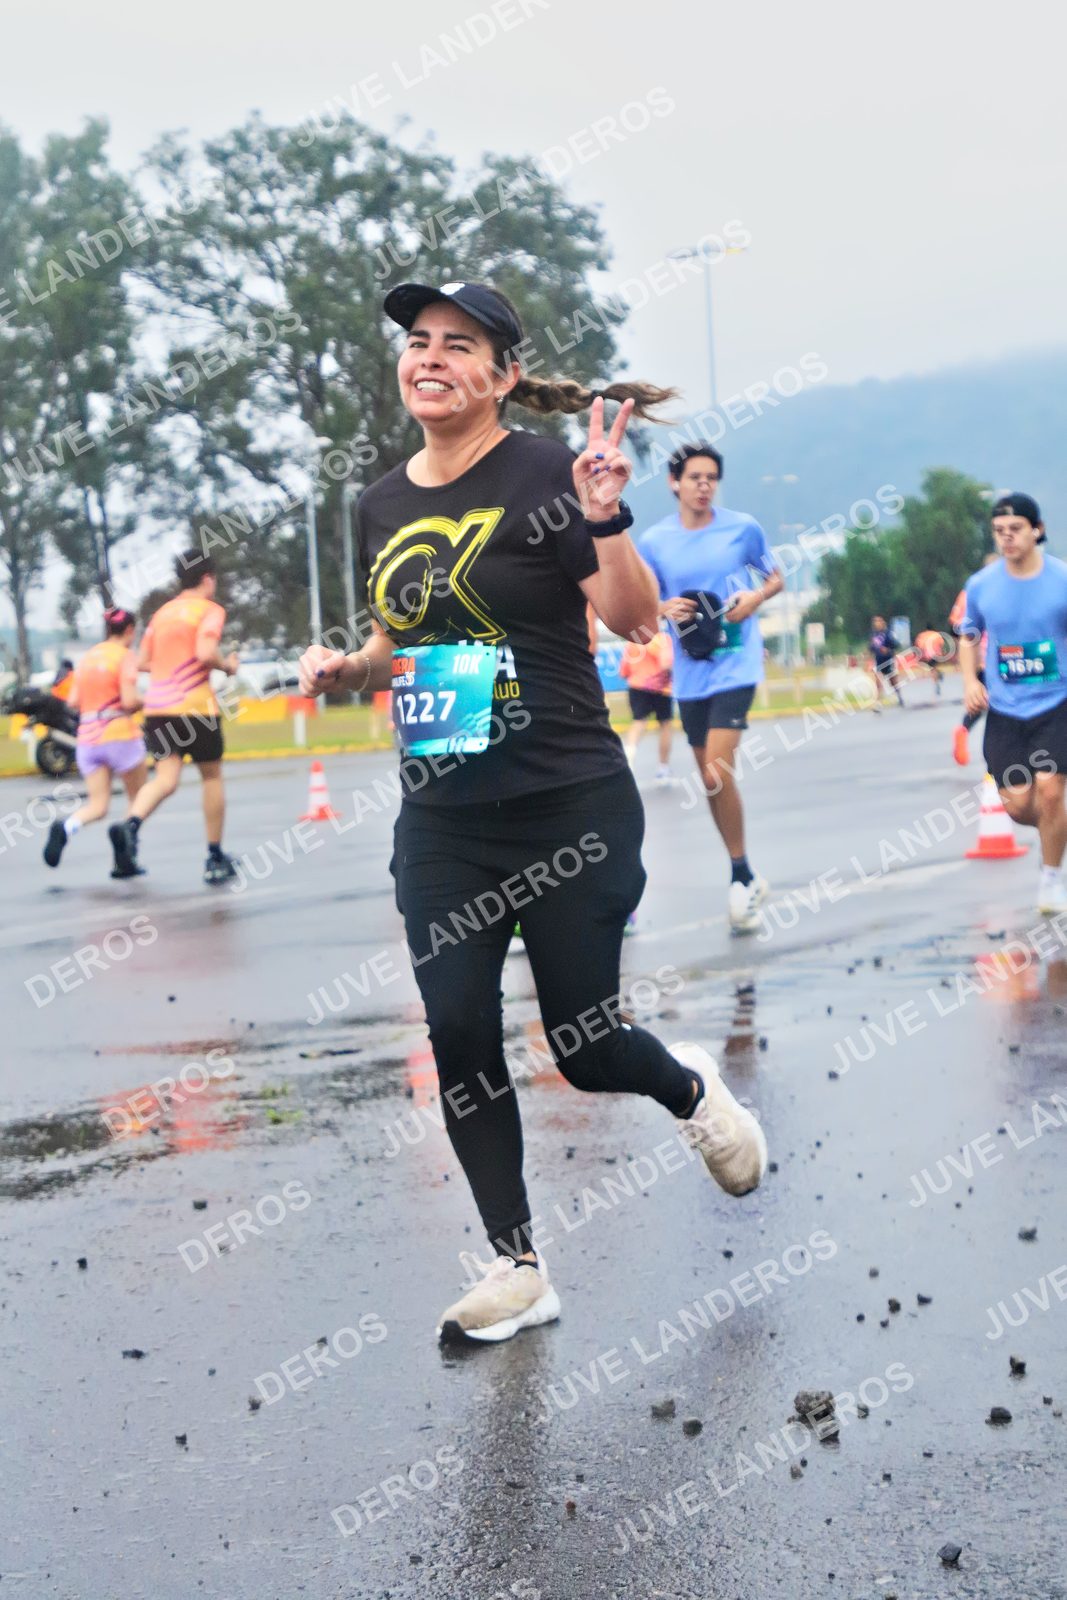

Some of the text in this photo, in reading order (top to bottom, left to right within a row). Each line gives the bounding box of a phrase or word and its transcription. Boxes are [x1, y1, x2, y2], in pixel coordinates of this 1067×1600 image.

[453, 654, 482, 674] 10K
[493, 680, 520, 699] lub
[397, 691, 456, 724] 1227
